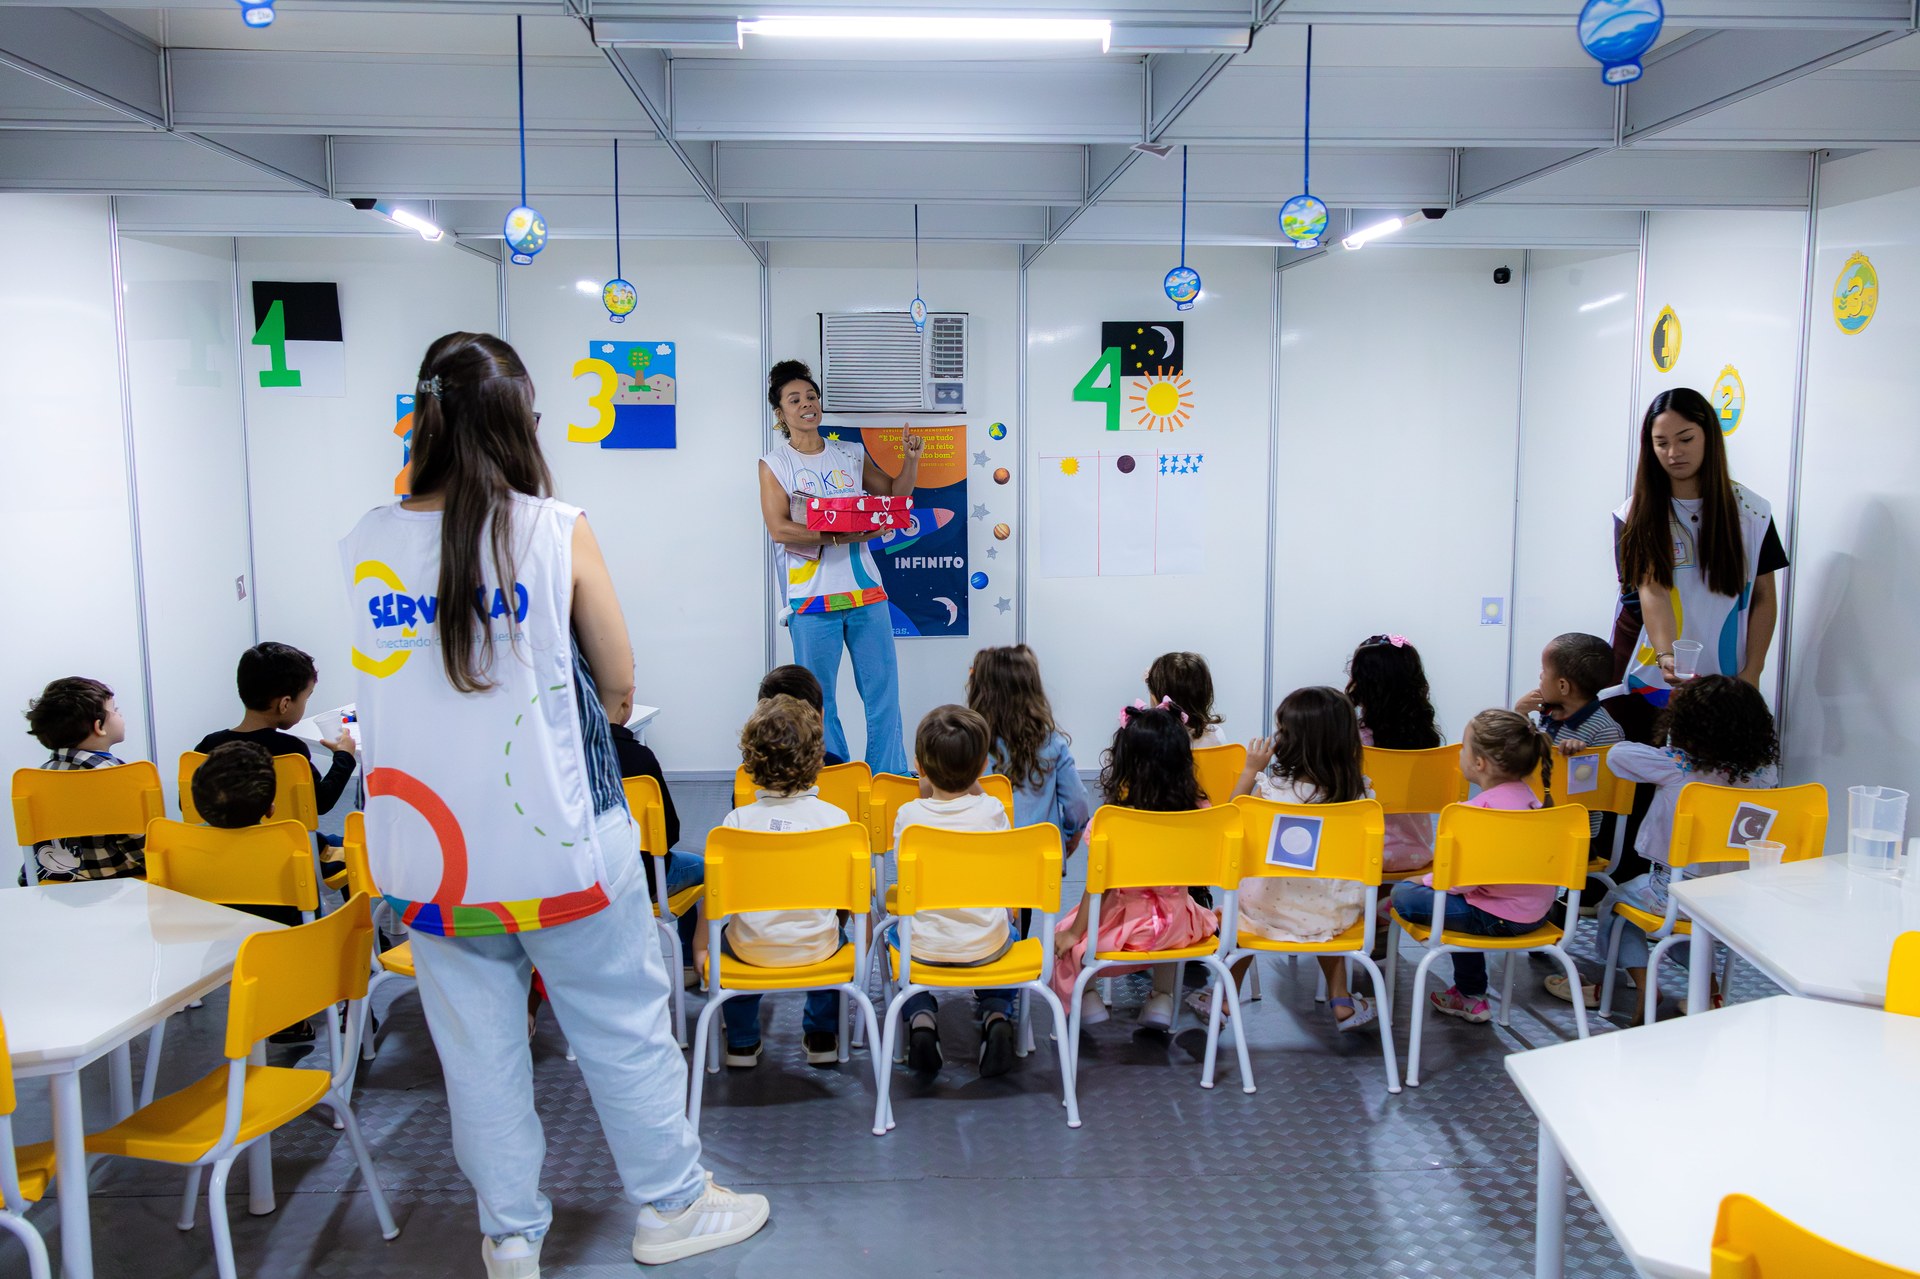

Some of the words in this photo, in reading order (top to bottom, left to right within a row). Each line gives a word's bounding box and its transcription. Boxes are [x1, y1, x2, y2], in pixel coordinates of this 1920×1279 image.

[252, 300, 302, 387] 1
[1661, 320, 1669, 357] 1
[567, 358, 619, 444] 3
[1073, 346, 1121, 431] 4
[1720, 385, 1734, 419] 2
[820, 469, 855, 490] KIDS
[895, 556, 965, 569] INFINITO
